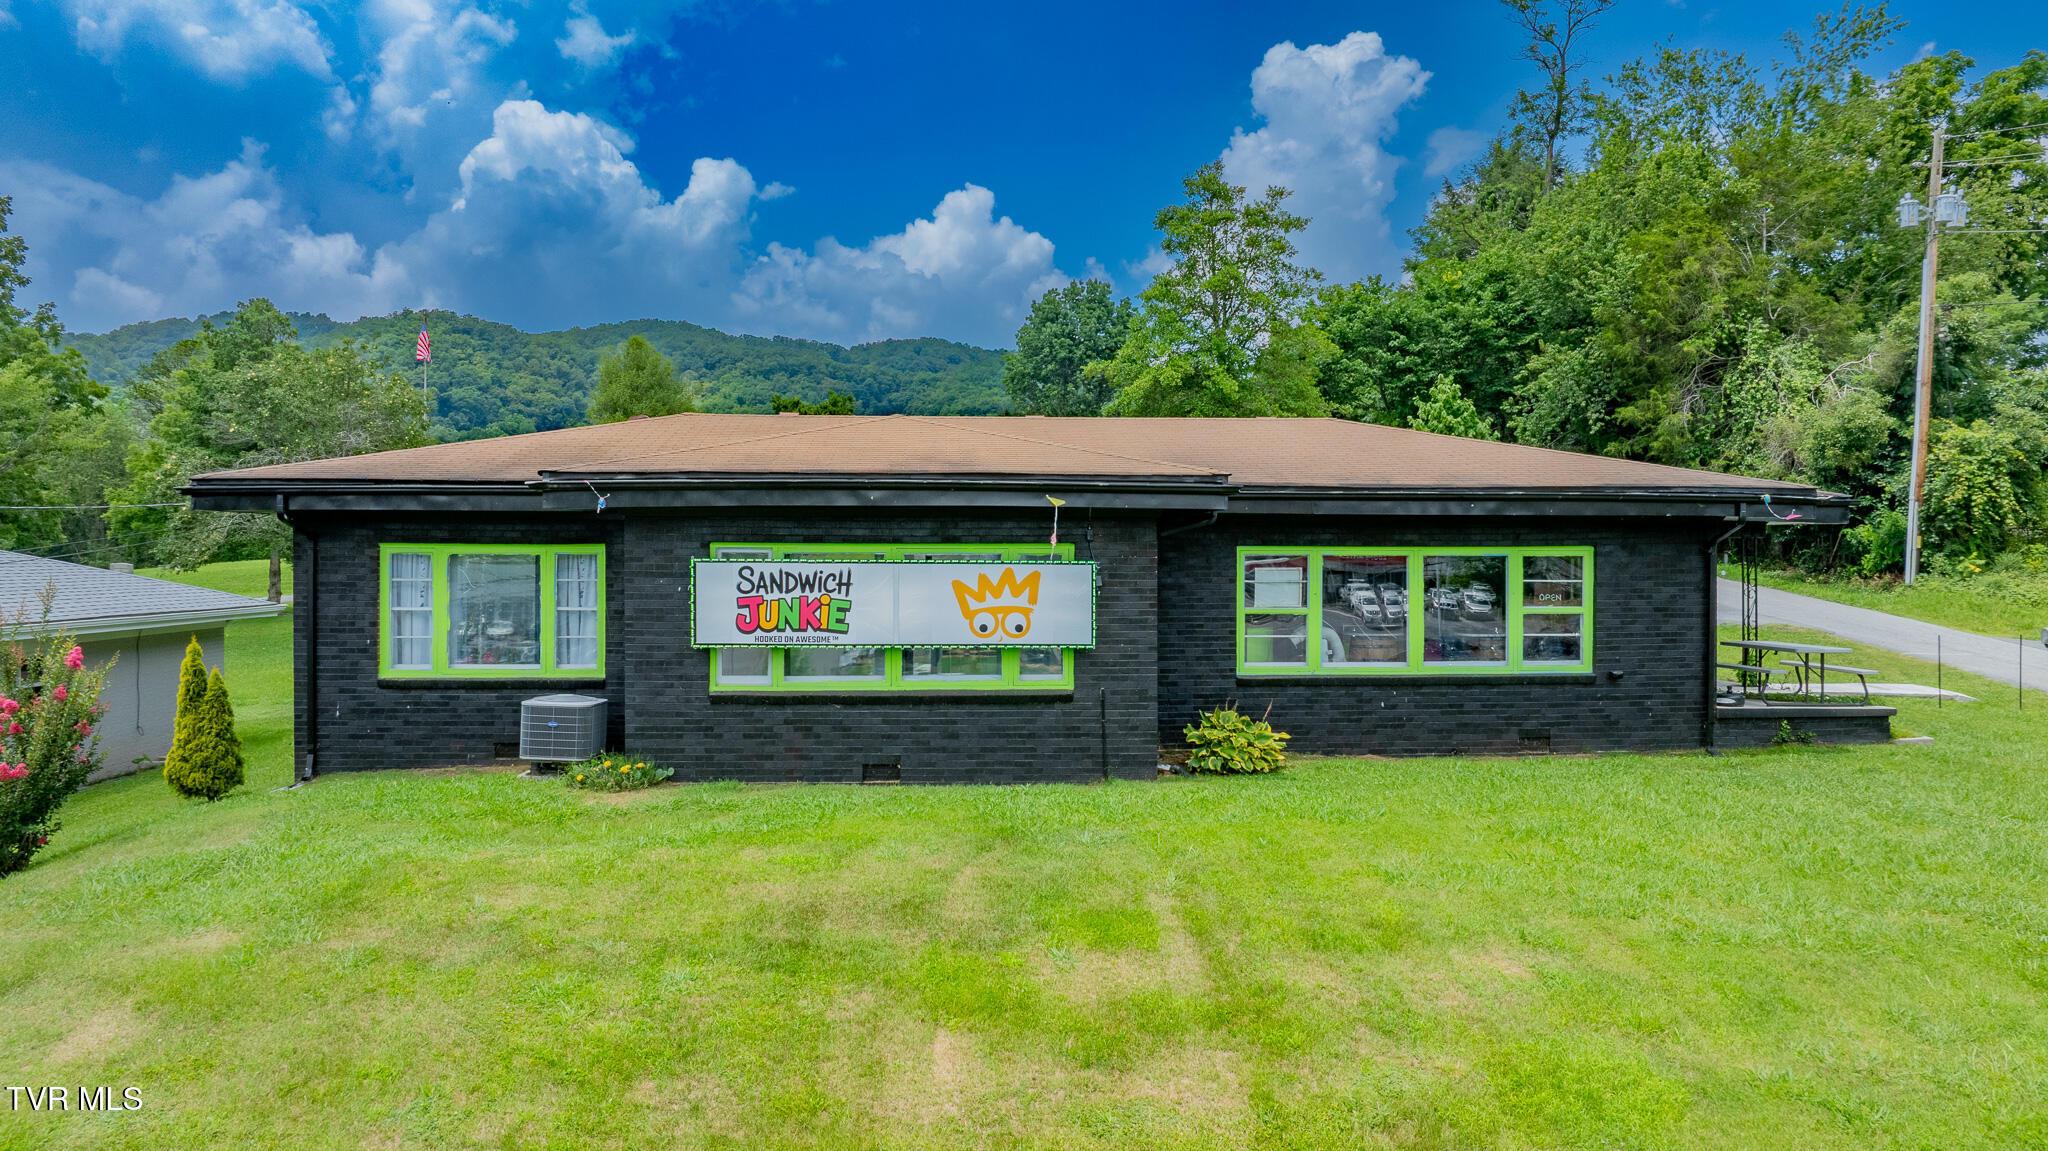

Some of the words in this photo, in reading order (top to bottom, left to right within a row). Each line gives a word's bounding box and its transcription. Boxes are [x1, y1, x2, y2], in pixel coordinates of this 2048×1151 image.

[1539, 593, 1562, 602] OPEN
[754, 635, 783, 643] HOOKED
[784, 635, 794, 643] ON
